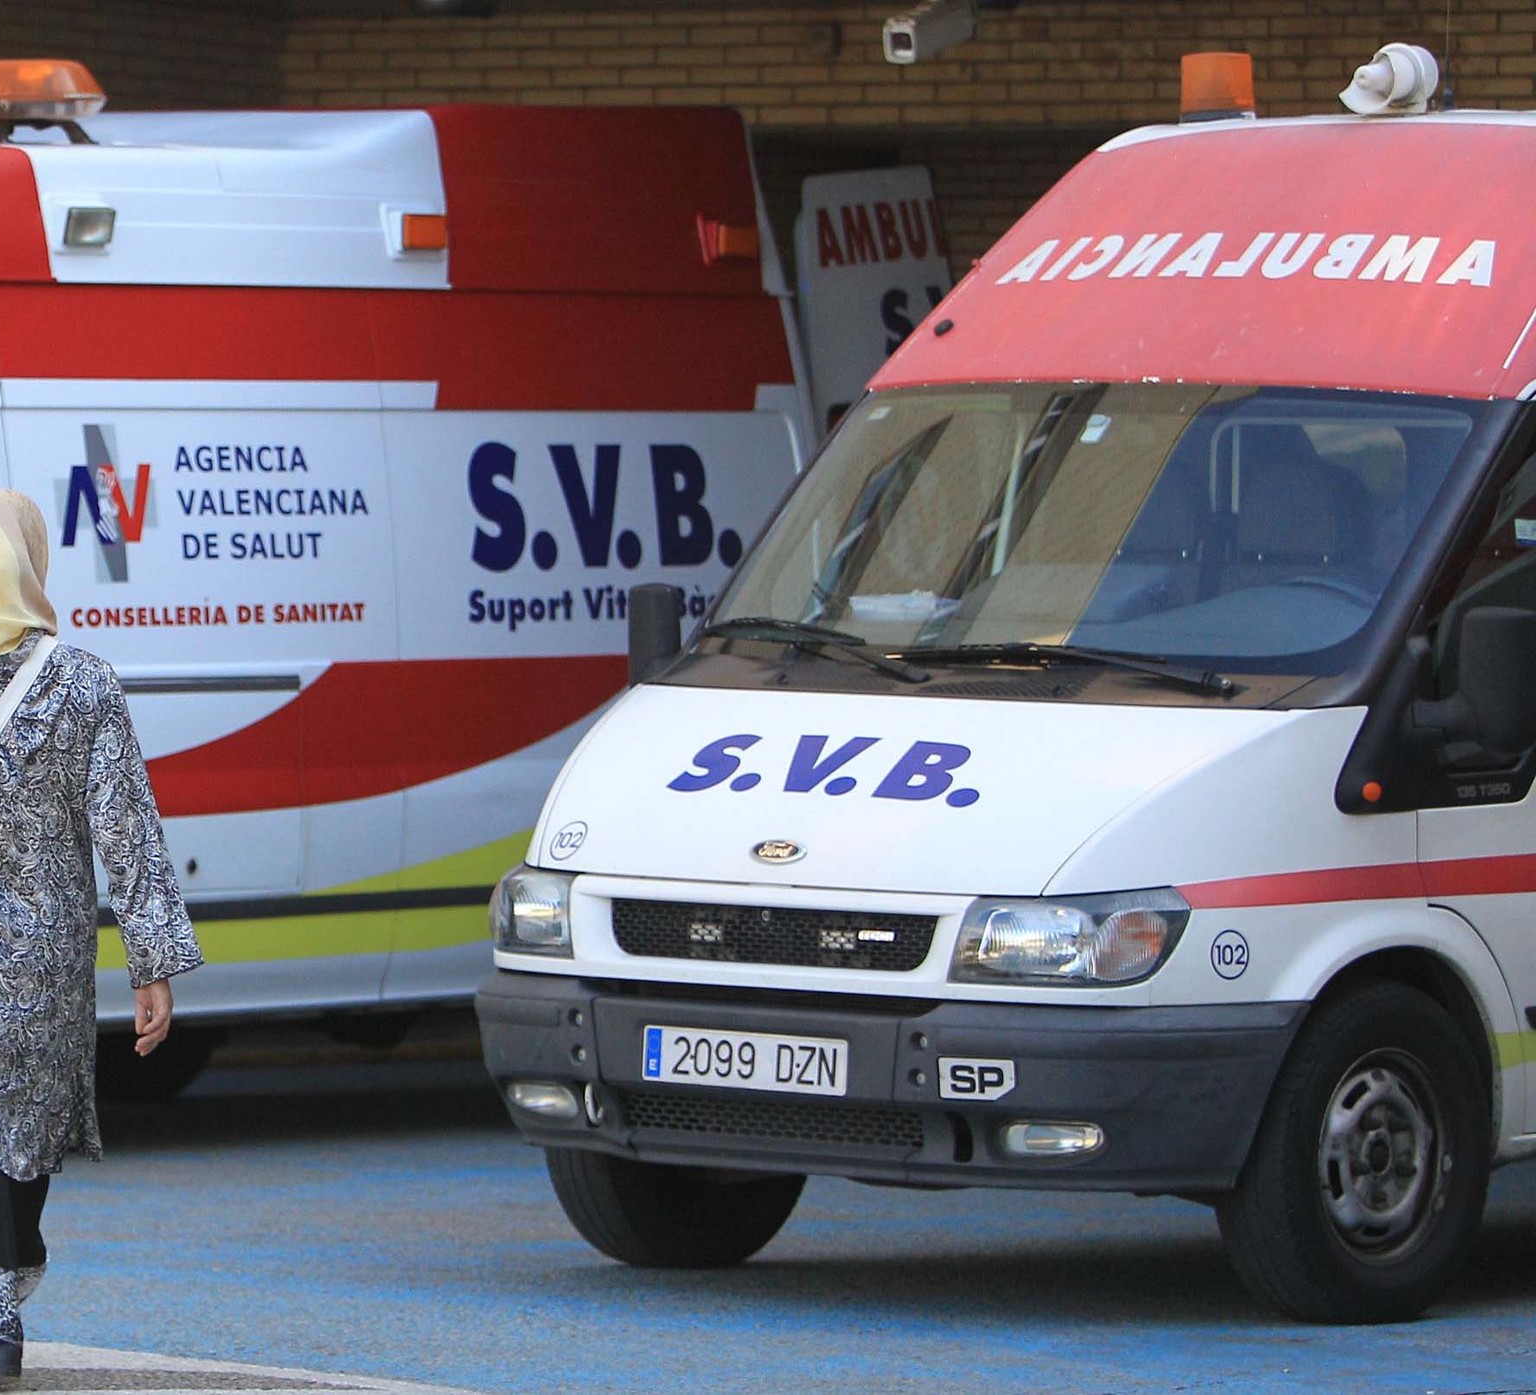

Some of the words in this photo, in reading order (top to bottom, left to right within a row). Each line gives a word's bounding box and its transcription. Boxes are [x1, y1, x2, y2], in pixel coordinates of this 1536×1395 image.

[174, 445, 308, 472] AGENCIA
[177, 488, 369, 516] VALENCIANA
[467, 440, 743, 573] S.V.B.
[182, 533, 219, 560] DE
[230, 532, 323, 559] SALUT
[237, 603, 265, 625] DE
[273, 602, 366, 624] SANITAT
[468, 587, 573, 633] Suport
[665, 733, 981, 809] S.V.B.
[554, 831, 582, 850] 102
[757, 840, 794, 858] Ford
[1214, 944, 1246, 966] 102
[648, 1058, 659, 1071] E
[671, 1035, 756, 1079] 2099
[949, 1063, 1005, 1095] SP
